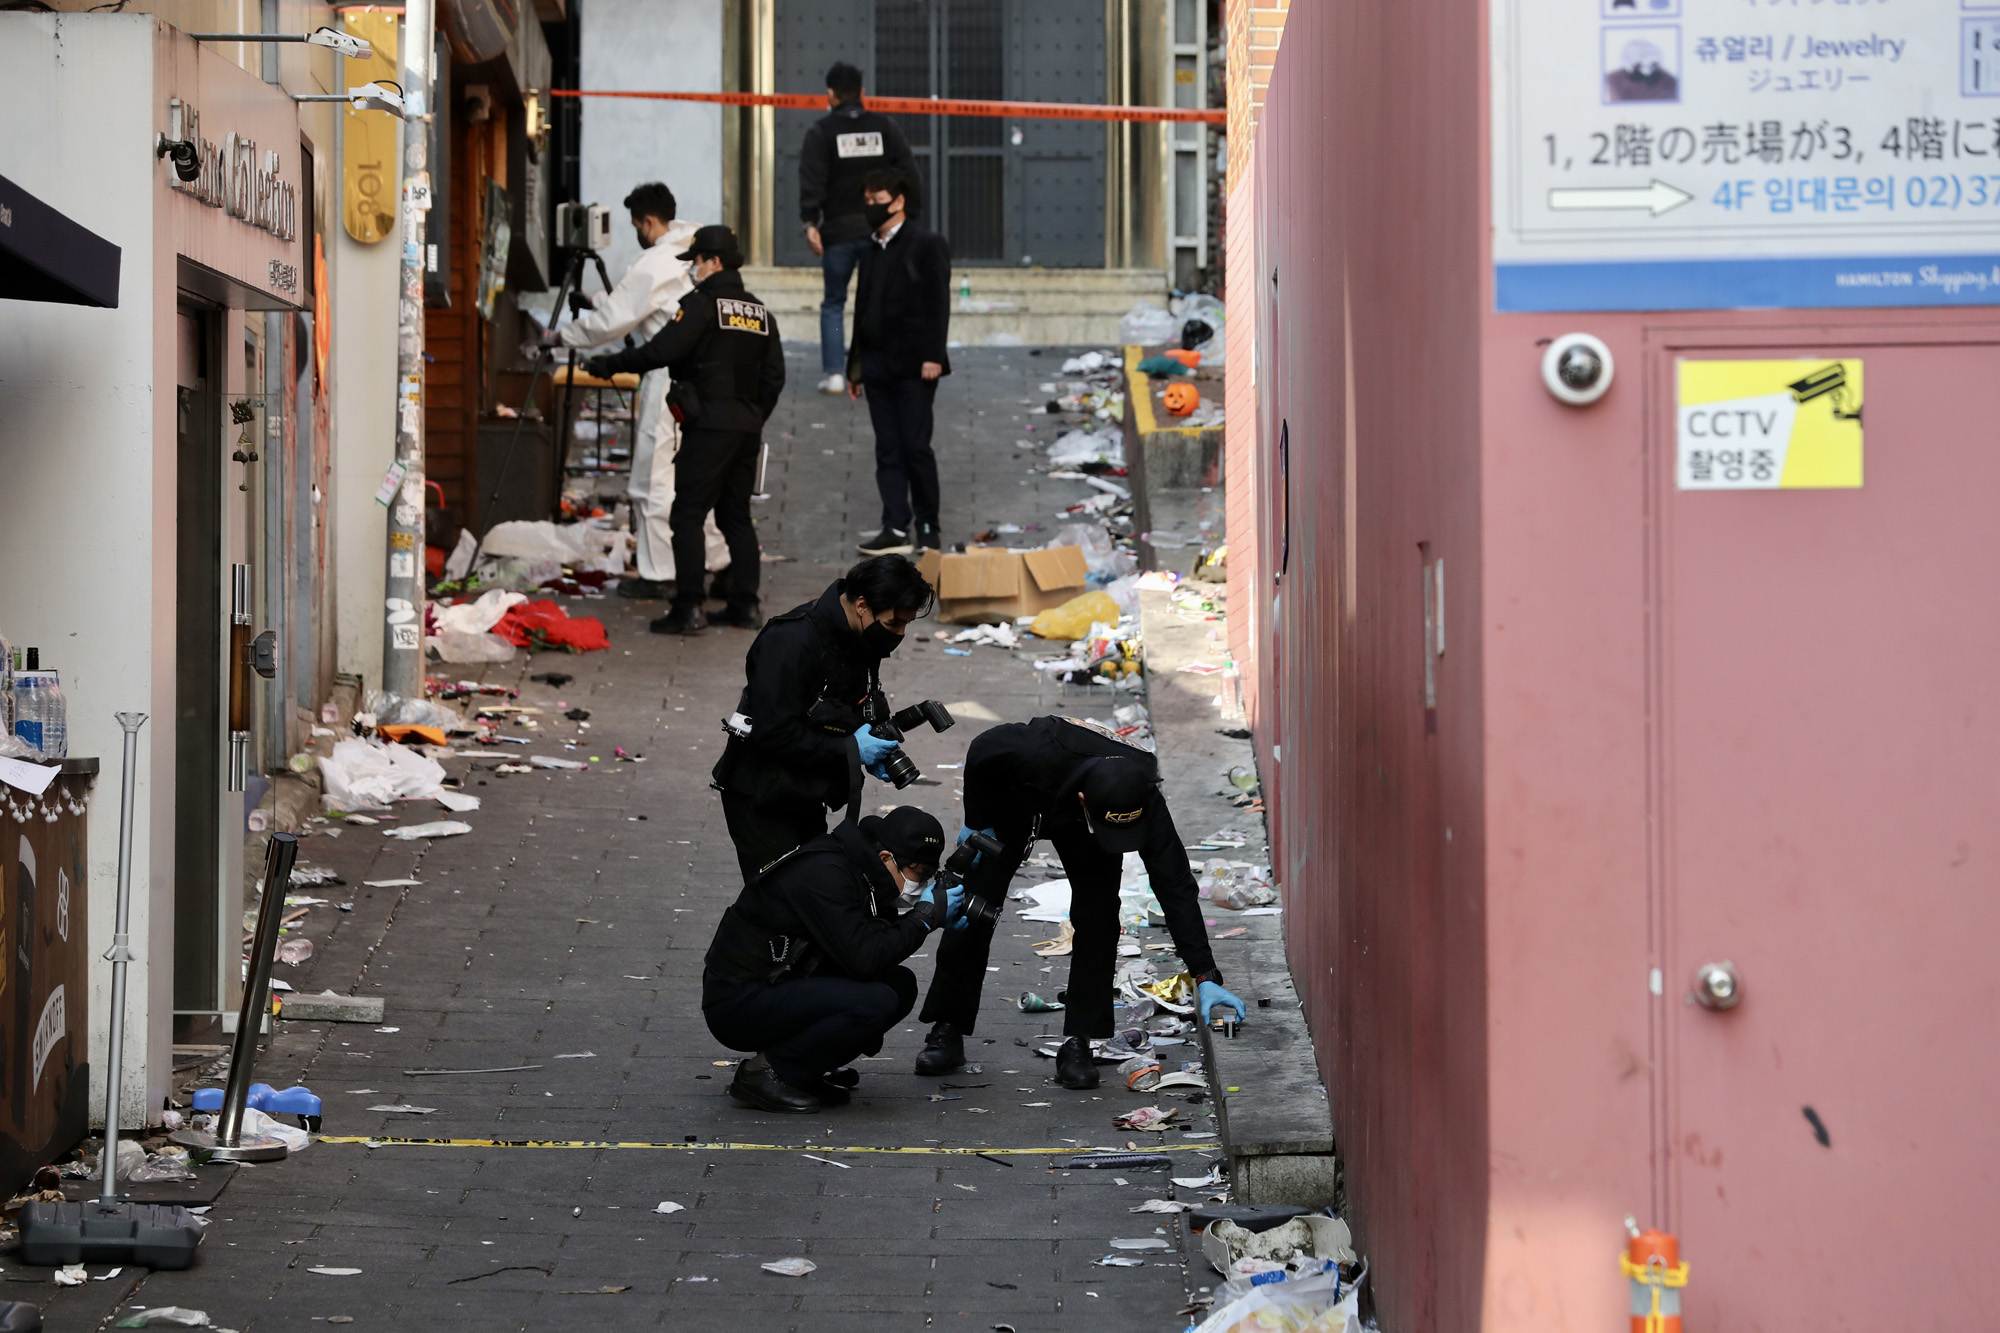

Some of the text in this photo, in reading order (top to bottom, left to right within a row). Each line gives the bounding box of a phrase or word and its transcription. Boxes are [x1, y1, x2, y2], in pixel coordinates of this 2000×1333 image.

[1695, 32, 1906, 63] 쥬얼리 / Jewelry
[1748, 66, 1871, 93] ジュエリー
[225, 131, 295, 242] Collection
[357, 160, 382, 216] 108
[1712, 180, 1756, 211] 4F
[1764, 174, 1895, 213] 임대문의
[1835, 271, 1914, 288] HAMILTON
[729, 315, 761, 331] POLICE
[1687, 410, 1777, 437] CCTV
[1688, 449, 1776, 481] 촬영중
